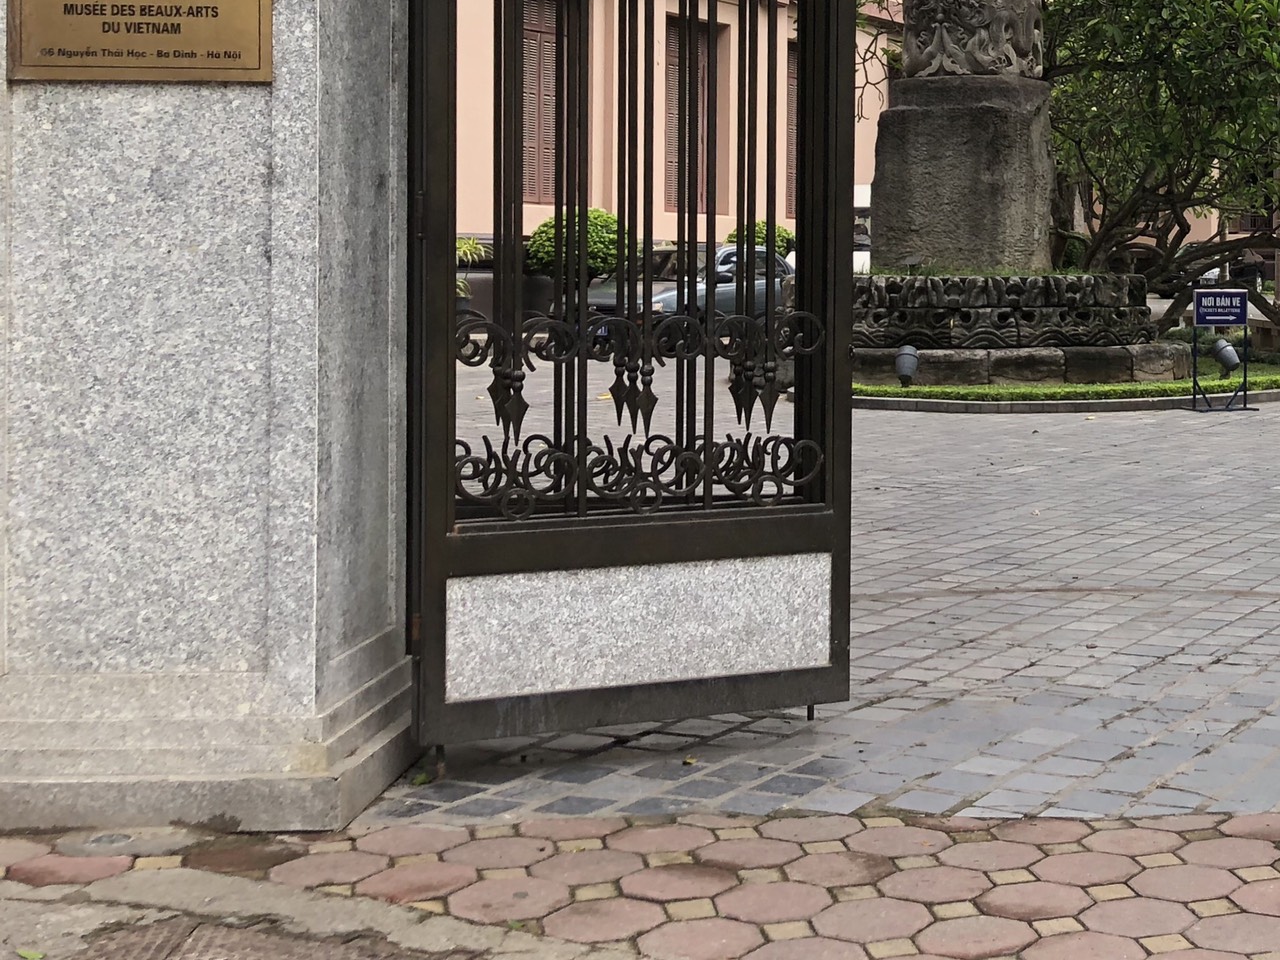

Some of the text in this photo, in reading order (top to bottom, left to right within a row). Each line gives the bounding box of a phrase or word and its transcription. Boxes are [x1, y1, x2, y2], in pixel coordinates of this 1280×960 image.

[64, 1, 218, 17] MUSÉE DES BEAUX-ARTS
[103, 22, 181, 34] DU VIETNAM
[41, 48, 54, 56] 66
[127, 49, 147, 60] Học
[156, 50, 169, 58] Ba
[1216, 295, 1230, 306] BÁN
